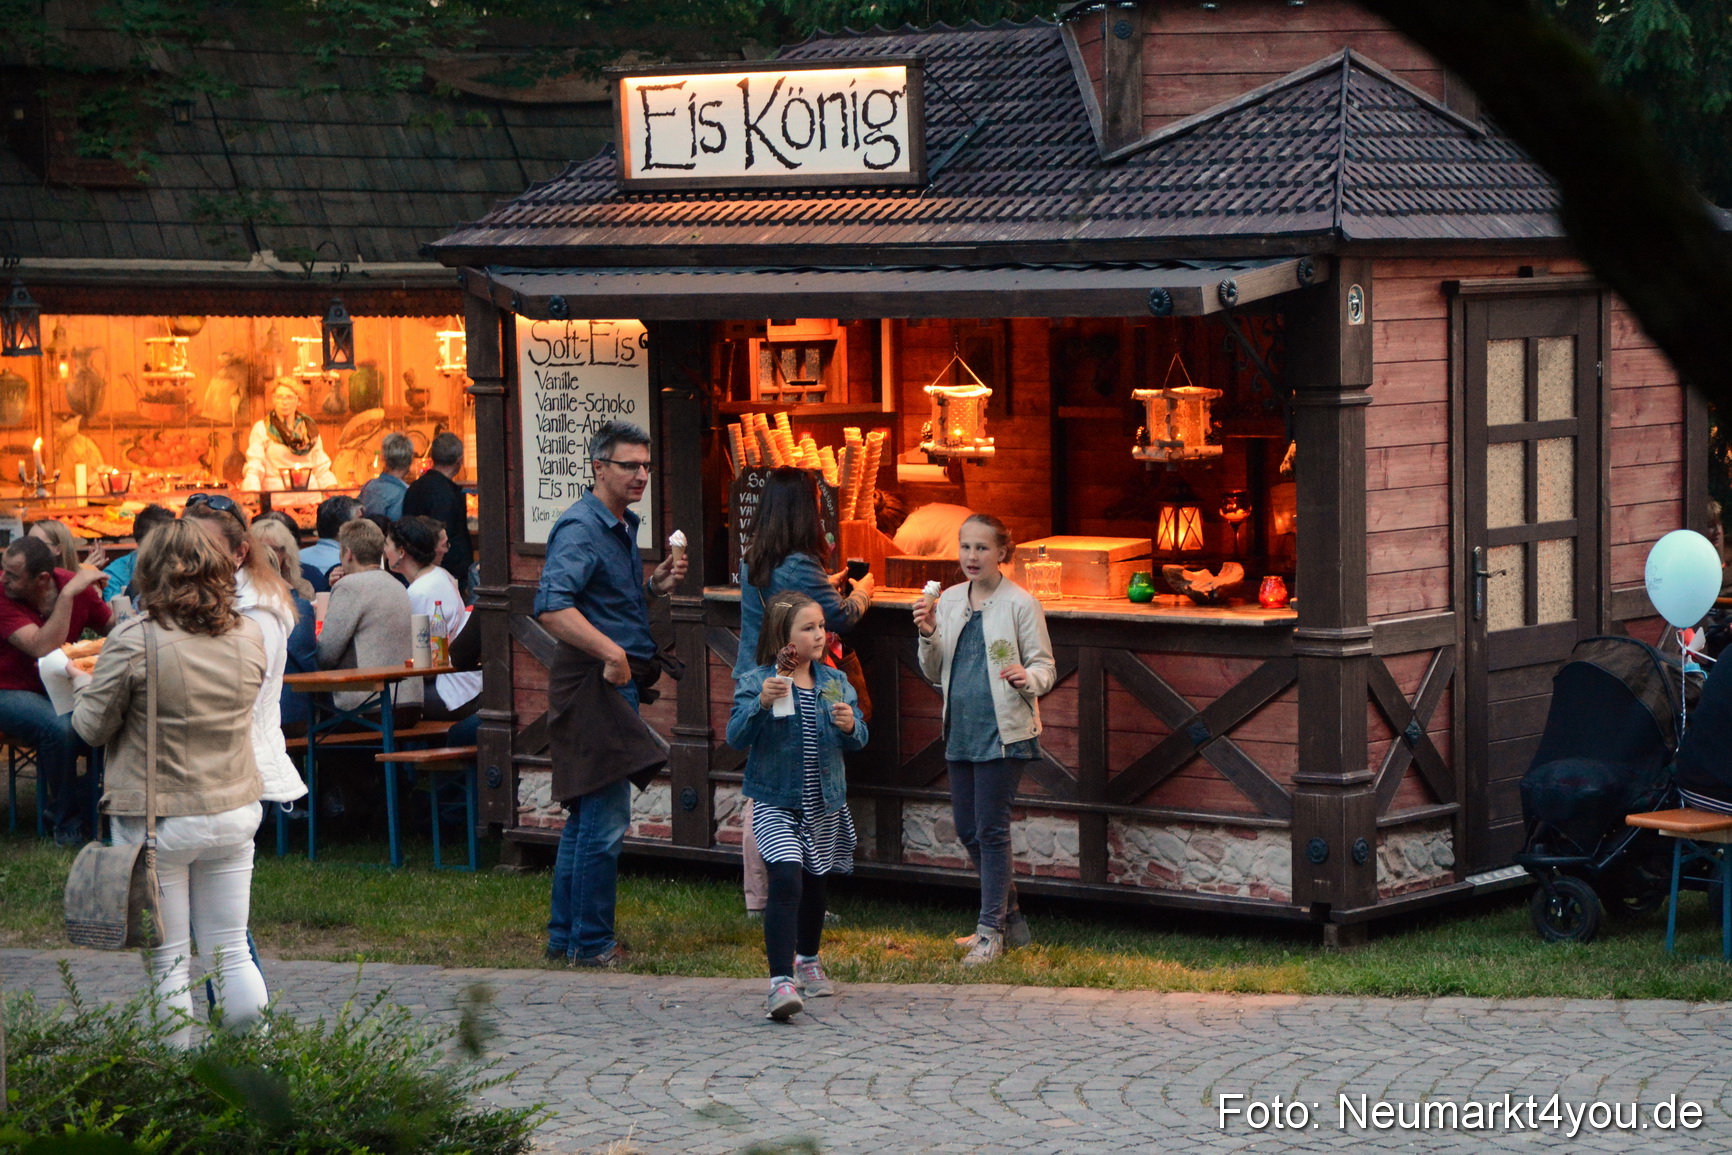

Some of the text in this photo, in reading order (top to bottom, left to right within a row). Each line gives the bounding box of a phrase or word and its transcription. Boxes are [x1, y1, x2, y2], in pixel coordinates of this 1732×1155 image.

[636, 76, 907, 171] Eis König
[528, 319, 636, 367] Soft-Eis
[535, 370, 579, 391] Vanille
[535, 392, 635, 415] Vanille-Schoko
[538, 478, 563, 500] Eis
[532, 506, 550, 523] Klein
